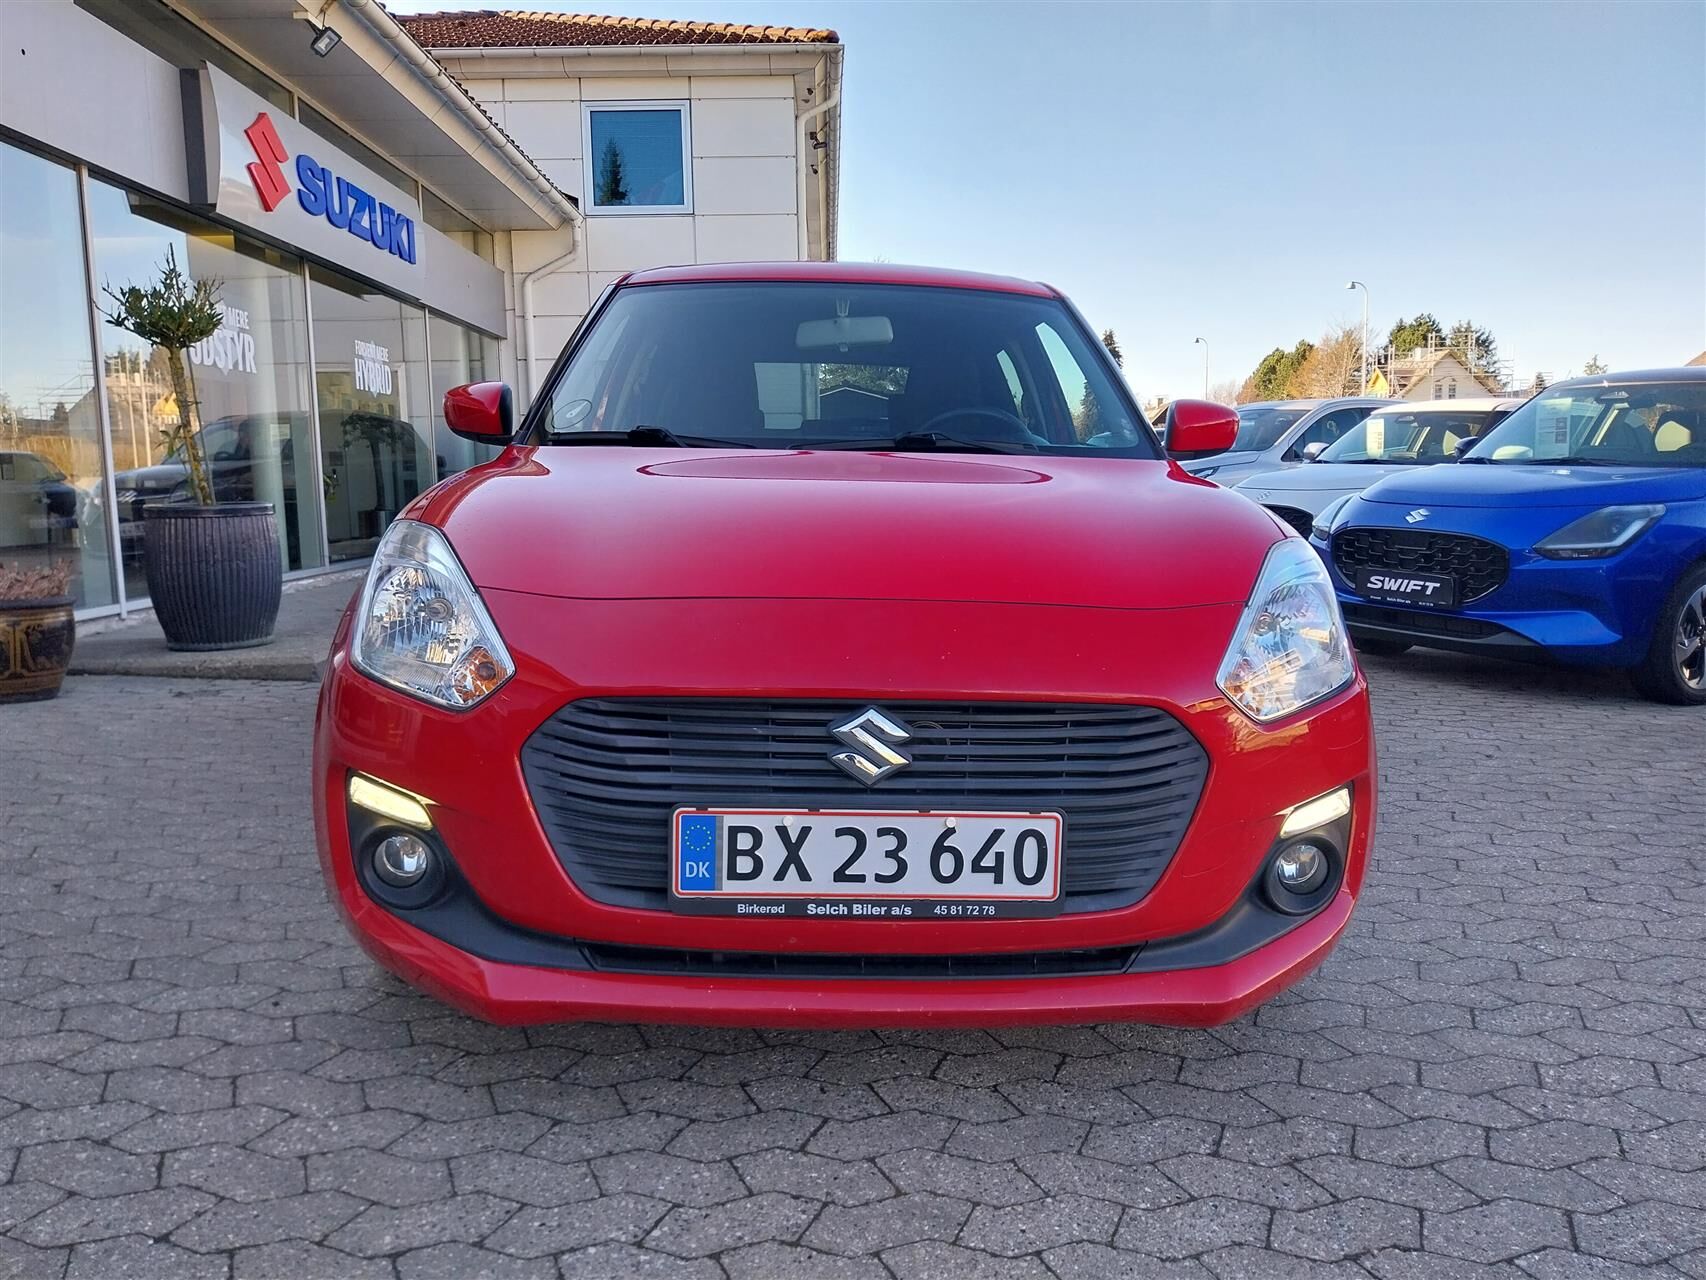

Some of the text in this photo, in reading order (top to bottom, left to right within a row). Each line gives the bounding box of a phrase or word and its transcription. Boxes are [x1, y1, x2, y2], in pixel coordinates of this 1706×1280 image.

[295, 154, 417, 265] SUZUKI
[227, 306, 249, 330] MERE
[375, 345, 390, 363] MERE
[354, 357, 392, 395] HYBRID
[1367, 575, 1441, 595] SWIFT
[726, 825, 1049, 886] BX 23 640
[685, 861, 711, 879] DK
[737, 903, 996, 916] Birkerød Selch Biler a/s 45 81 72 78
